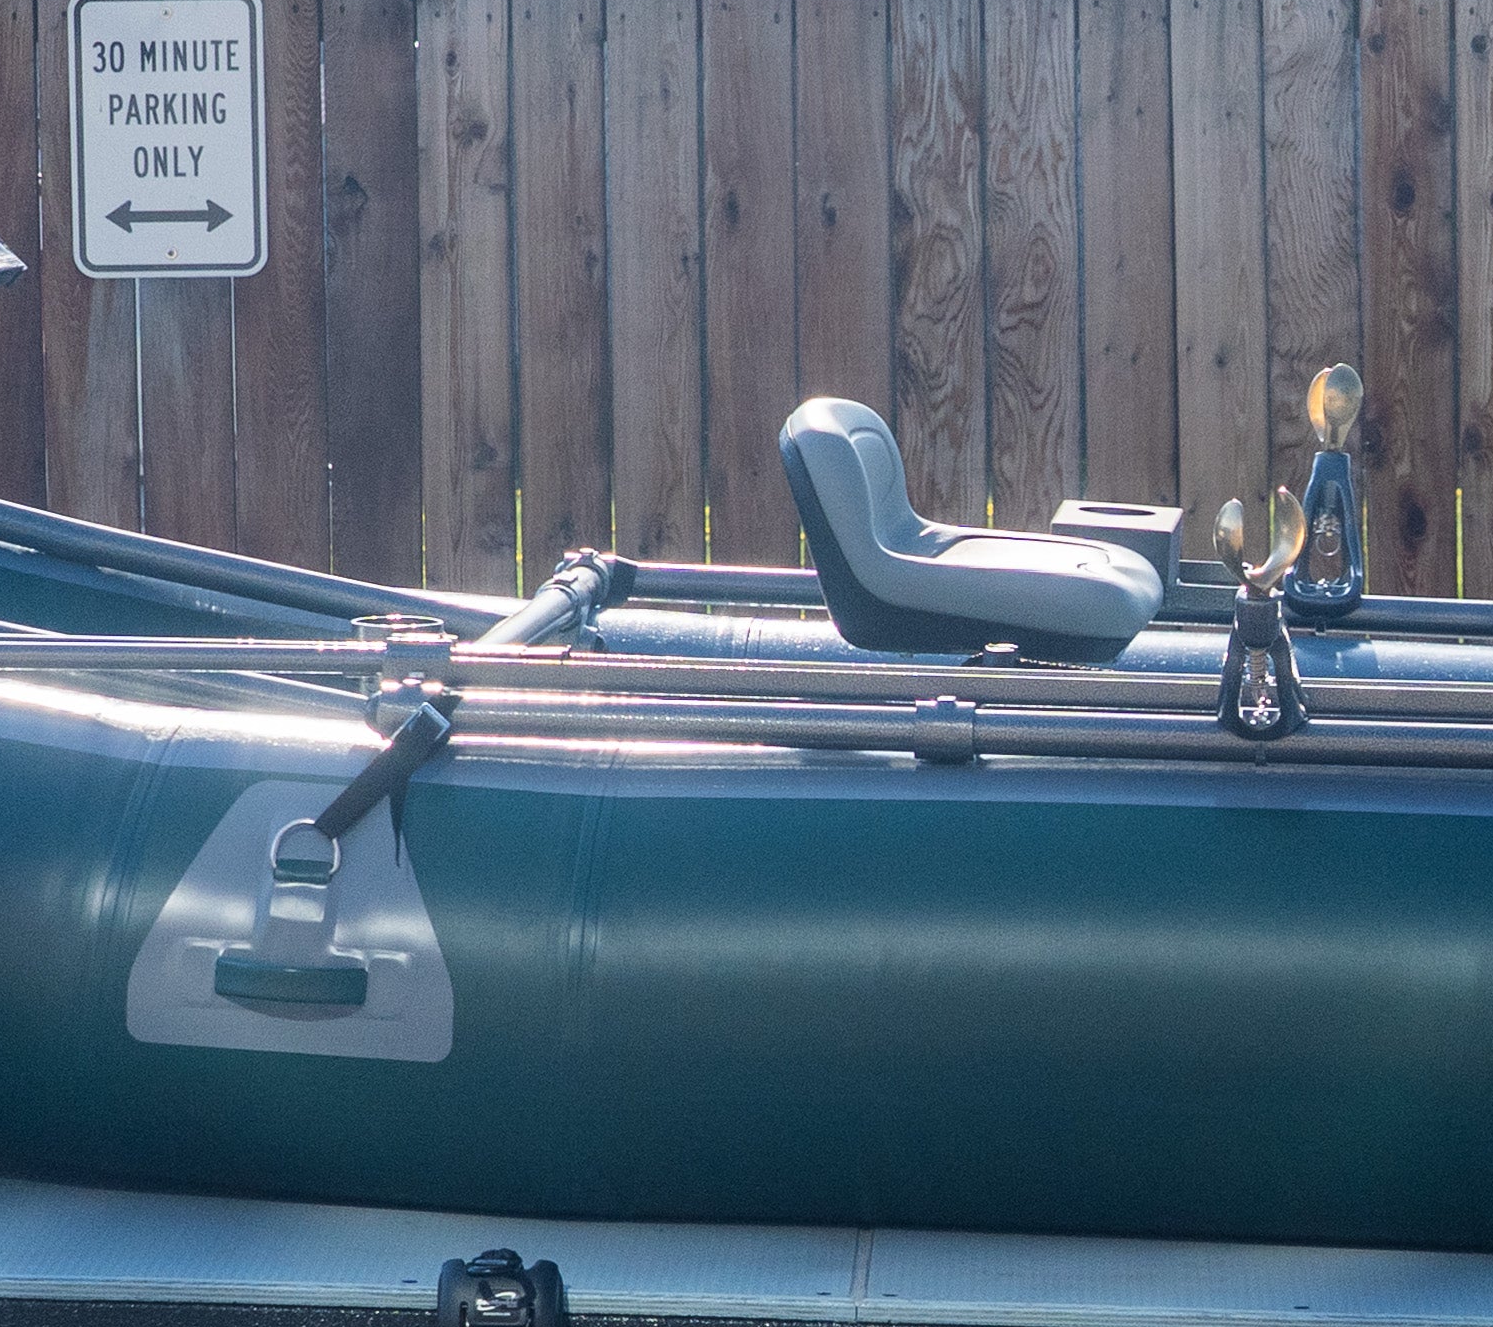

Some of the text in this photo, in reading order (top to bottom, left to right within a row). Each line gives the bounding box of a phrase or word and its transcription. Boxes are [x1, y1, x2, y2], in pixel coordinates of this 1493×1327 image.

[92, 39, 240, 73] 30 MINUTE
[108, 92, 227, 126] PARKING
[133, 145, 205, 178] ONLY
